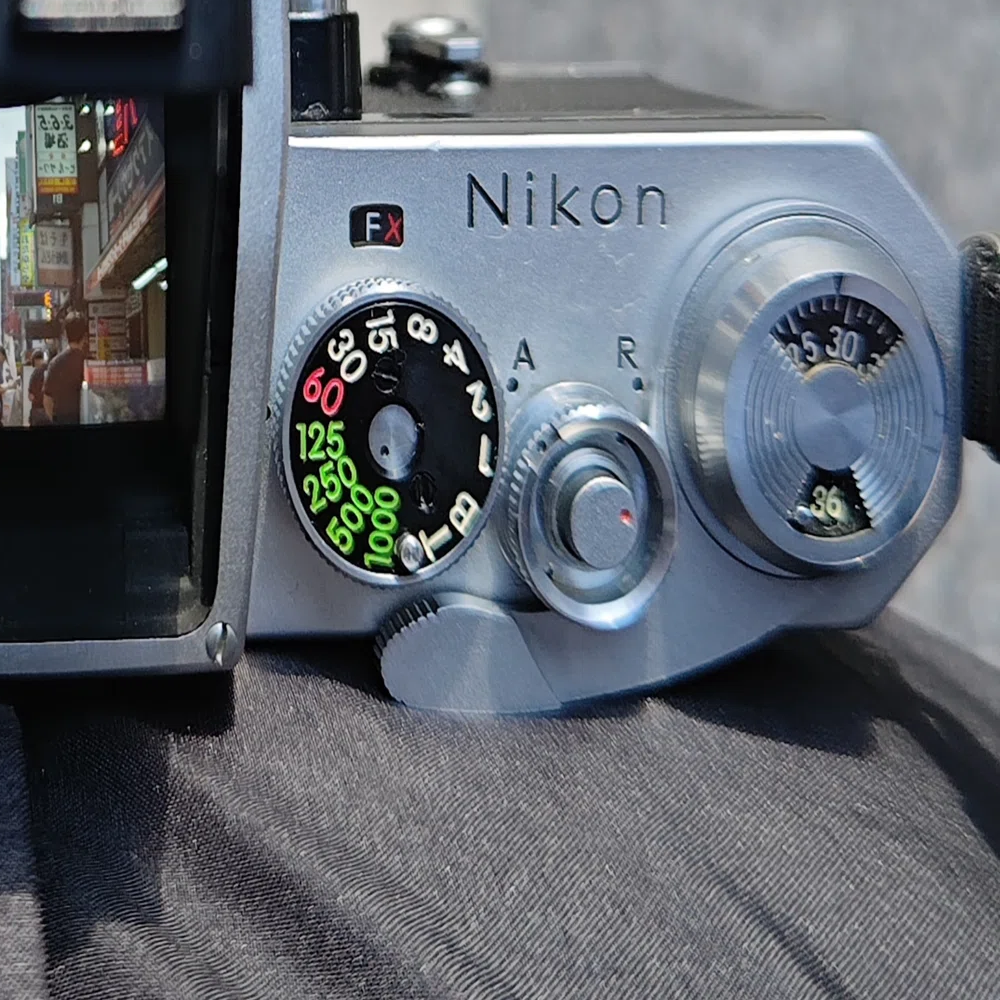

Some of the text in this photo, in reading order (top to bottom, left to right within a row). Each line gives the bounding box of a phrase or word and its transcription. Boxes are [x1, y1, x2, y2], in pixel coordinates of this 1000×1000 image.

[466, 170, 668, 229] Nikon
[364, 212, 402, 243] FX
[365, 309, 400, 353] 15
[407, 312, 440, 345] 8
[825, 325, 858, 361] 30
[327, 328, 368, 384] 30
[442, 339, 471, 376] 4
[512, 337, 537, 371] A
[617, 336, 639, 369] R
[303, 366, 345, 417] 60
[465, 379, 492, 423] 2
[296, 420, 345, 463] 125
[478, 433, 494, 478] 1
[303, 455, 357, 515] 250
[809, 484, 842, 519] 36
[325, 484, 374, 555] 500
[364, 486, 400, 570] 1000
[449, 490, 484, 538] B
[418, 524, 453, 563] T
